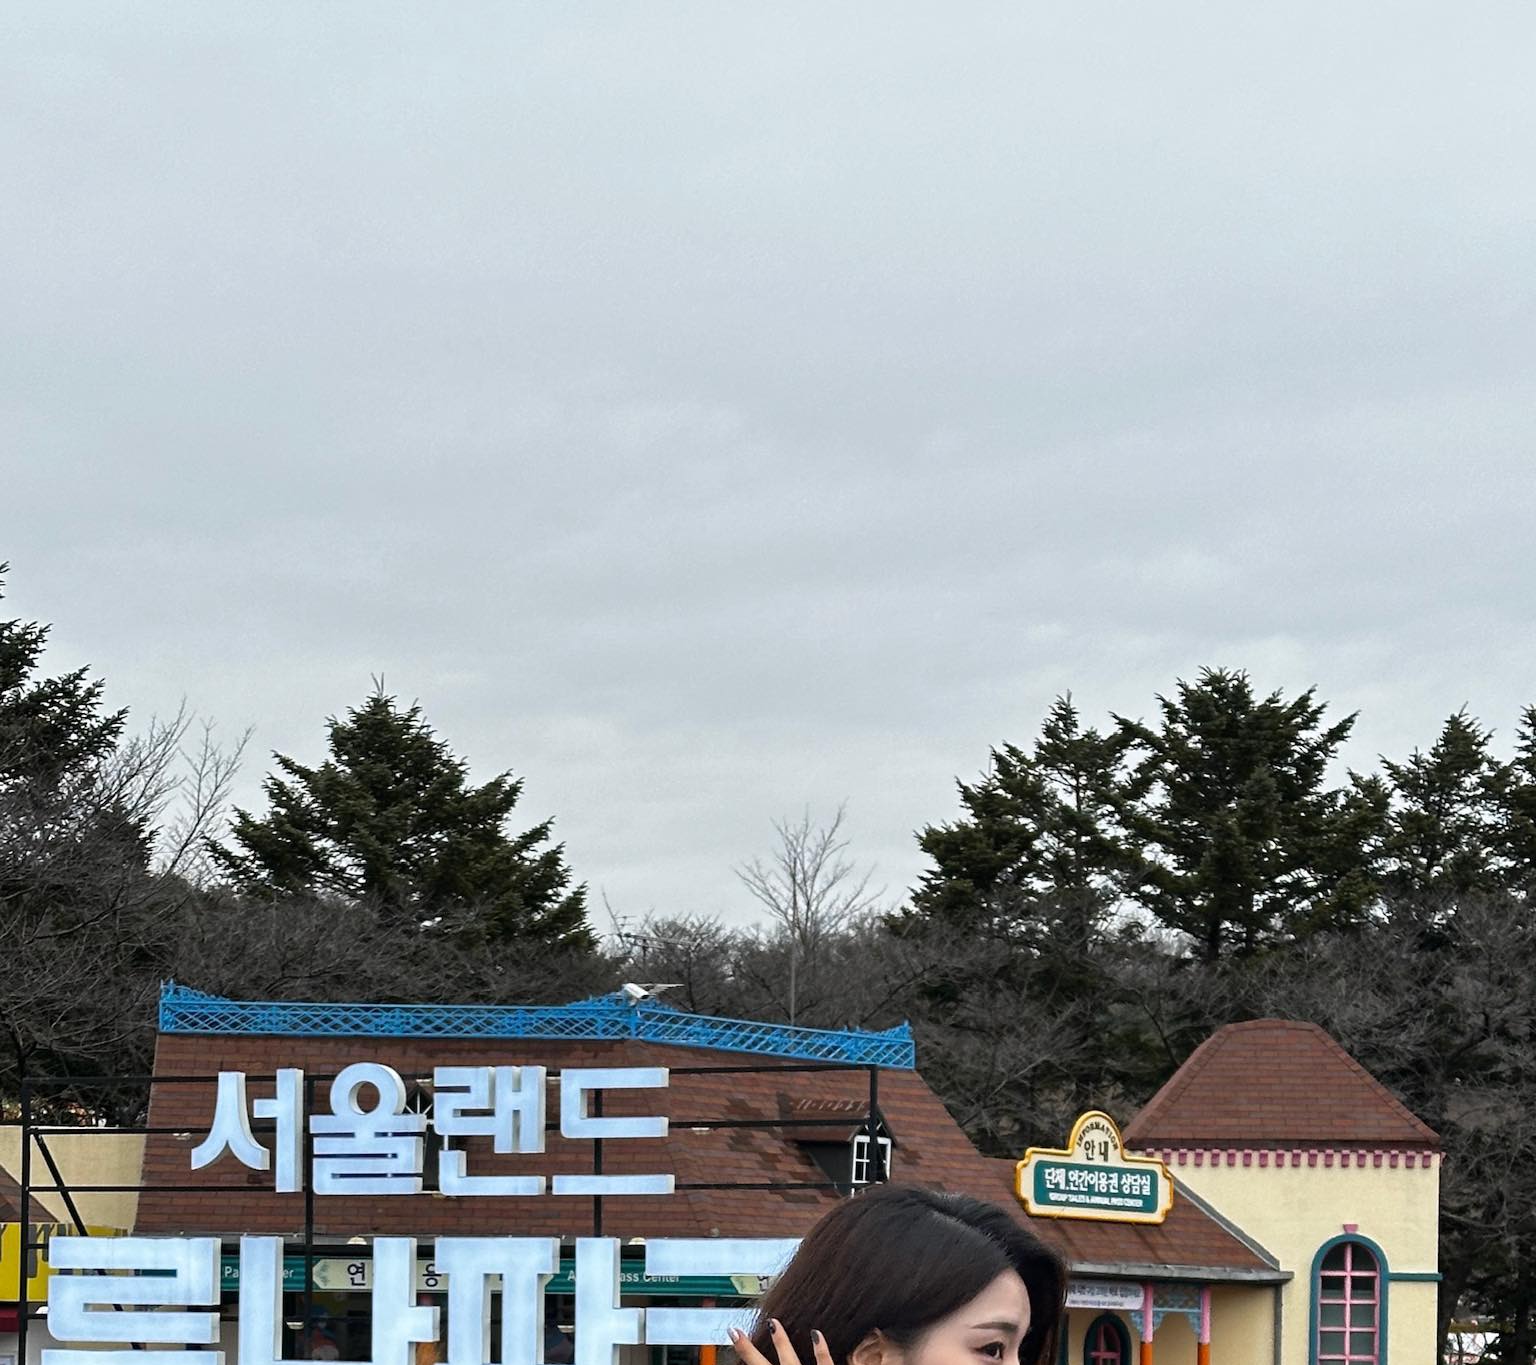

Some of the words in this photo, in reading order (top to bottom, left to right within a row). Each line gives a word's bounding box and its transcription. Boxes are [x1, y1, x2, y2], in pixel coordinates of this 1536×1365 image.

[191, 1062, 676, 1196] 서울랜드
[1076, 1122, 1118, 1150] INFORMATION
[1120, 1173, 1151, 1195] 상담실
